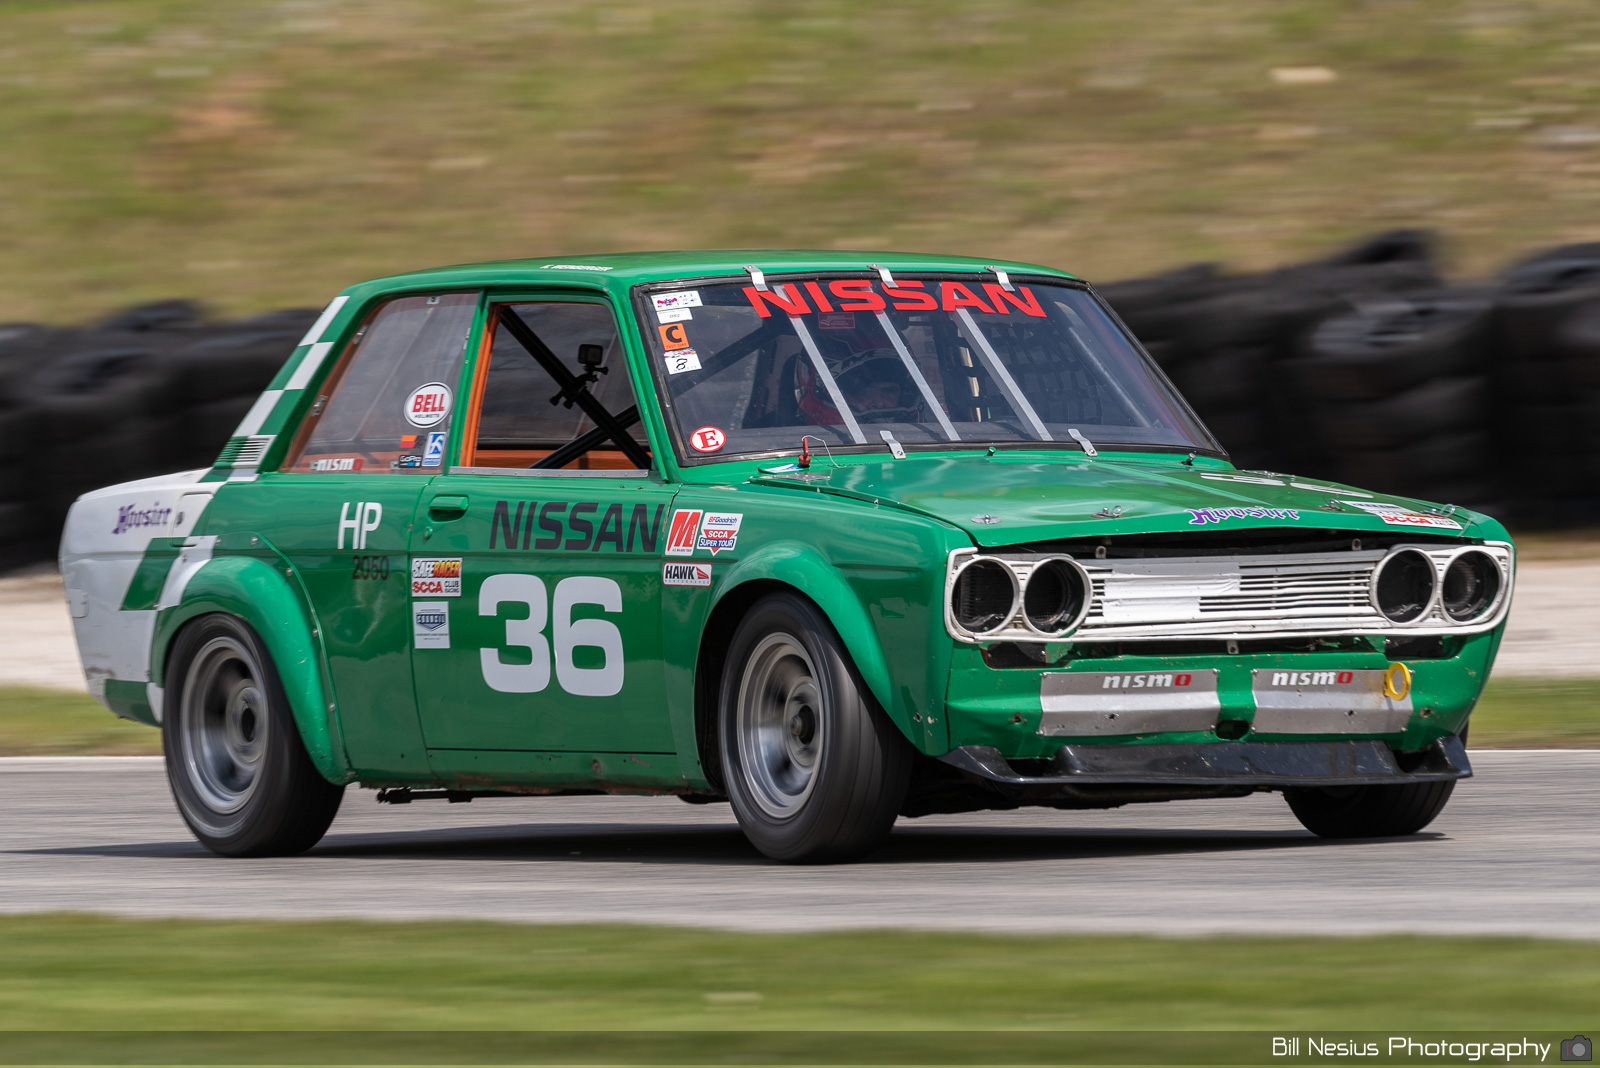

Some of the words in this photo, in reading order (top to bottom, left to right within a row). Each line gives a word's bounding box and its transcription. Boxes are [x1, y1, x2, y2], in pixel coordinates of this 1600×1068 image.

[742, 279, 1047, 318] NISSAN
[666, 326, 683, 343] C
[412, 393, 445, 413] BELL
[697, 430, 719, 449] E
[316, 458, 364, 471] nismo
[112, 500, 172, 534] Hoosier
[1185, 505, 1301, 525] Hoosier
[1381, 515, 1433, 525] SCCA
[337, 502, 383, 550] HP
[489, 501, 665, 552] NISSAN
[708, 530, 729, 538] SCCA
[699, 538, 717, 547] SUPER
[718, 540, 734, 548] TOUR
[351, 555, 390, 581] 2050
[664, 565, 696, 580] HAWK
[412, 581, 443, 593] SCCA
[444, 580, 460, 588] CLUB
[478, 573, 625, 697] 36
[1102, 673, 1192, 689] nismo
[1271, 671, 1354, 687] nismo
